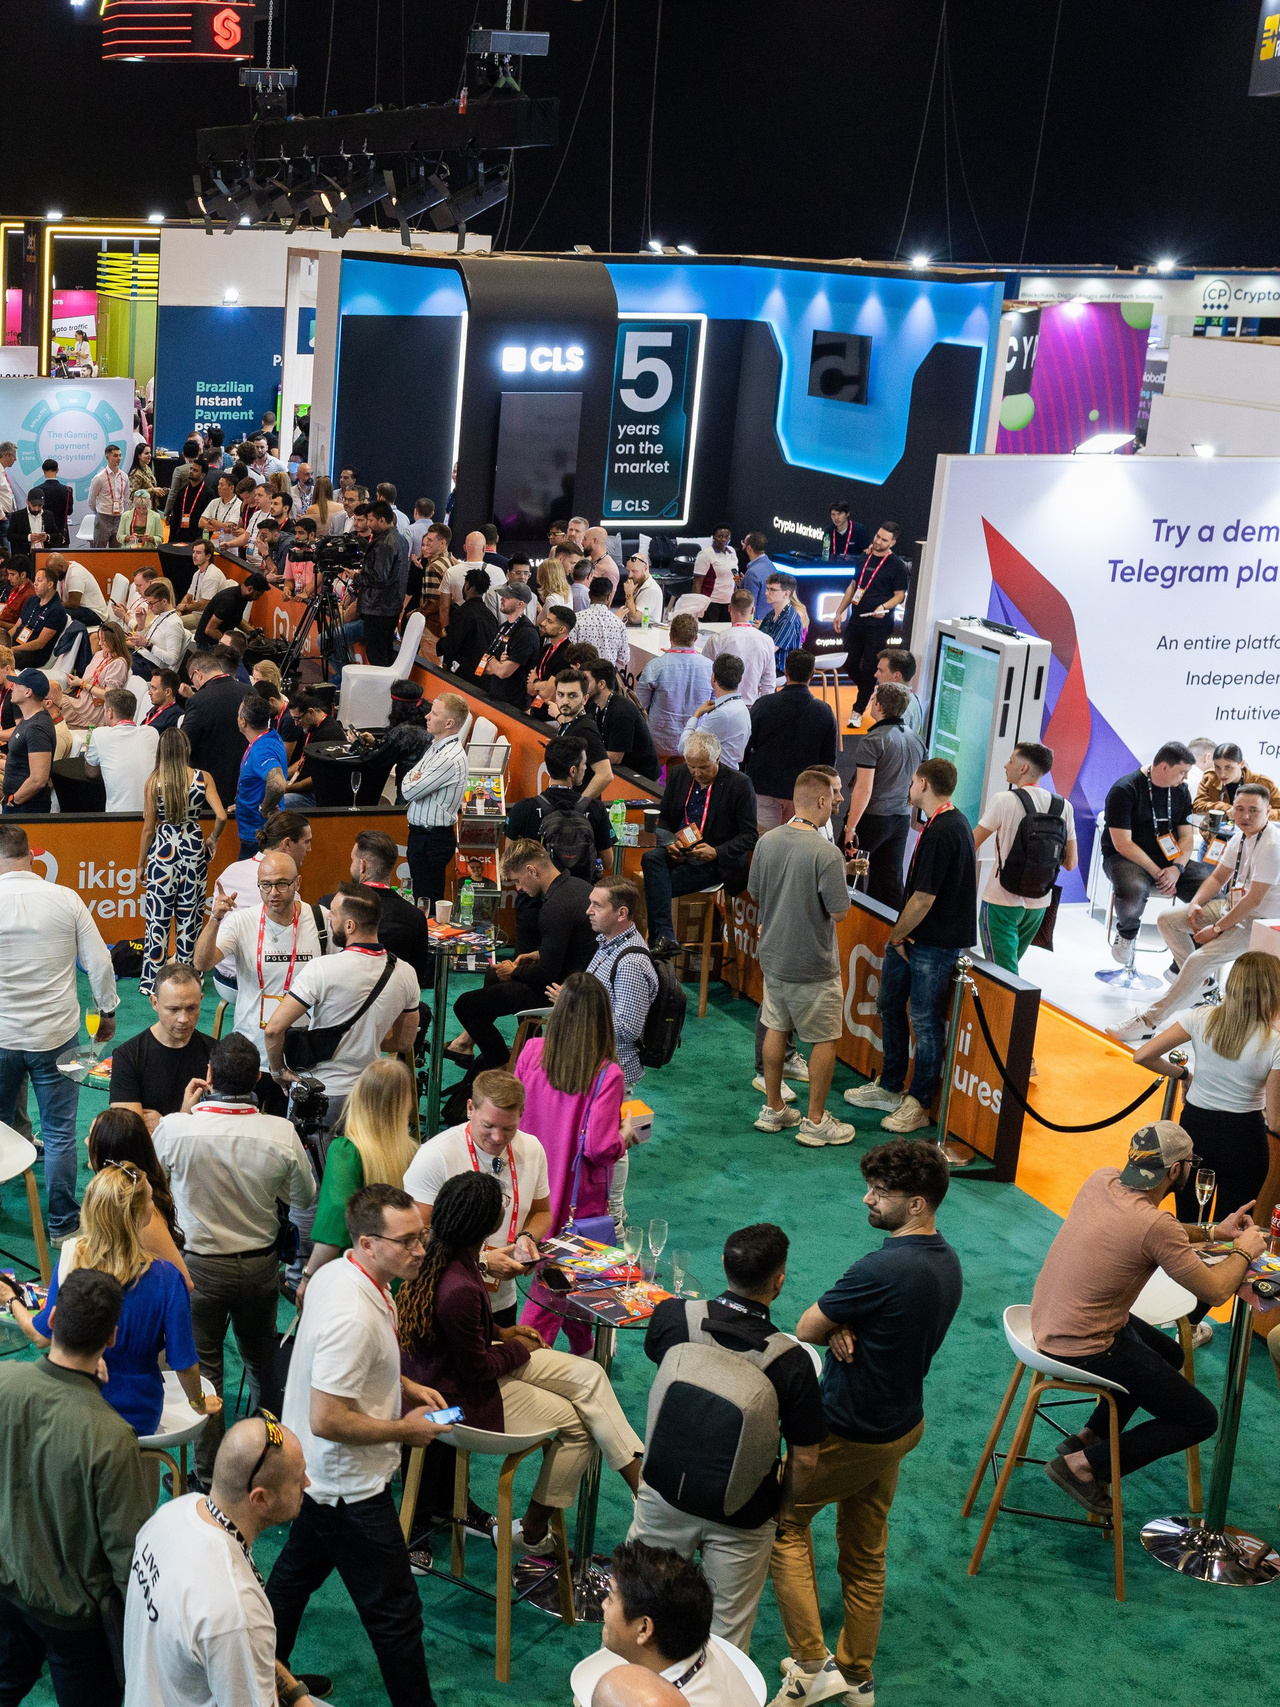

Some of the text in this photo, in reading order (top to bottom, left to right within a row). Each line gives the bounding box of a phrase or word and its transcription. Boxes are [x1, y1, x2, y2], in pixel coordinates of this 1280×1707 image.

[1208, 288, 1228, 300] CP
[530, 346, 584, 371] CLS
[620, 331, 673, 413] 5
[196, 381, 254, 393] Brazilian
[195, 395, 243, 407] Instant
[195, 409, 254, 422] Payment
[47, 430, 98, 441] The iGaming
[617, 423, 660, 439] years
[54, 443, 90, 451] payment
[616, 441, 664, 454] on the
[614, 460, 670, 473] market
[624, 500, 650, 512] CLS
[773, 516, 795, 534] Crypto
[1152, 518, 1280, 549] Try a dem
[1108, 558, 1280, 589] Telegram pla
[1156, 634, 1280, 653] An entire platfo
[1215, 705, 1280, 720] Intuitive
[78, 860, 138, 895] ikig
[954, 1064, 1003, 1114] ures
[142, 1543, 160, 1588] LIVE
[132, 1558, 160, 1623] ASINO
